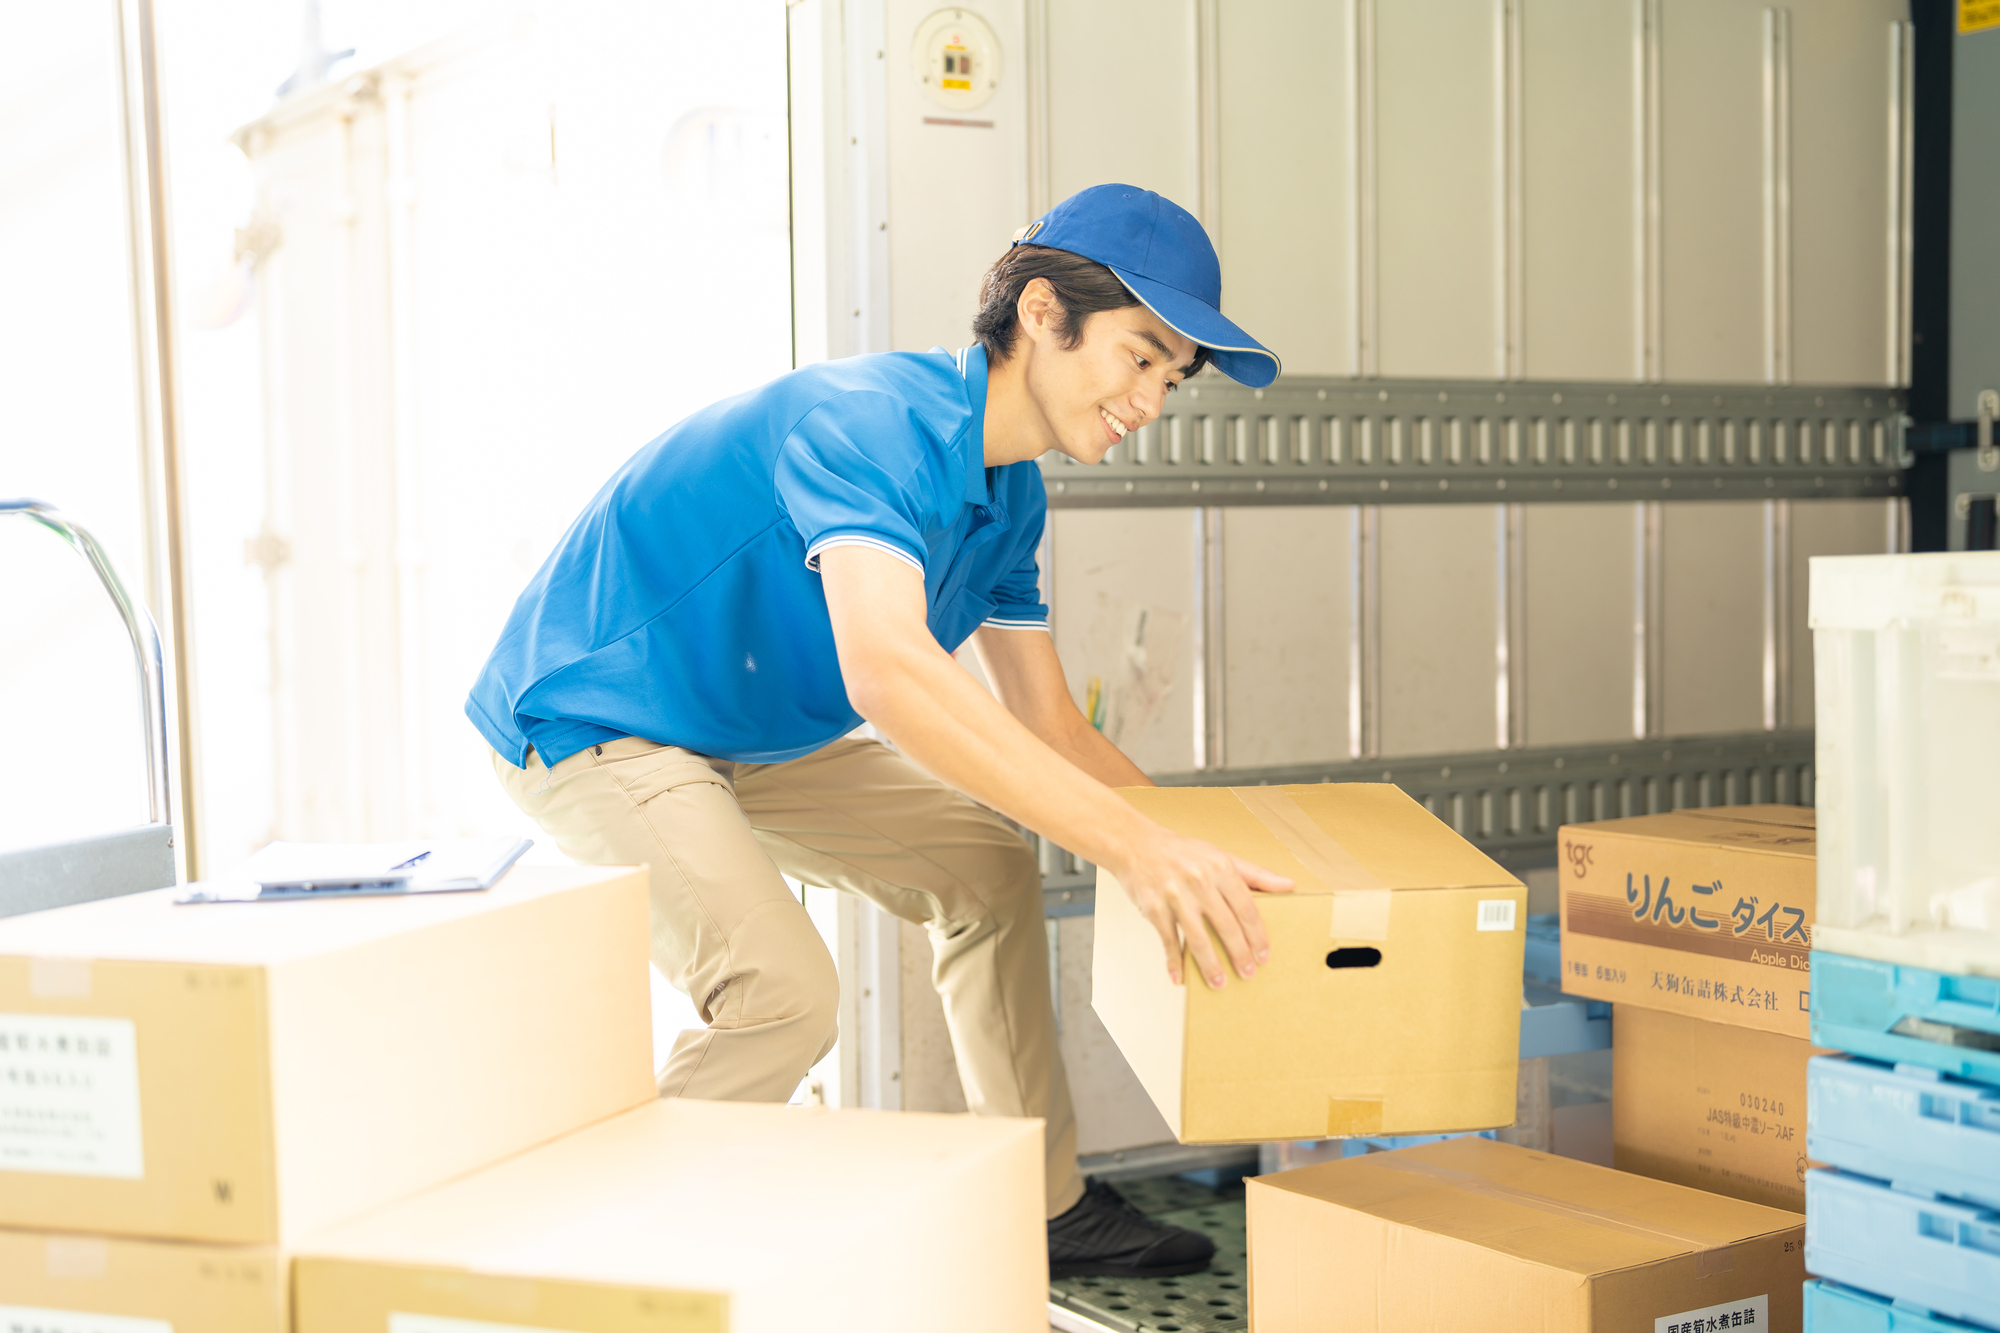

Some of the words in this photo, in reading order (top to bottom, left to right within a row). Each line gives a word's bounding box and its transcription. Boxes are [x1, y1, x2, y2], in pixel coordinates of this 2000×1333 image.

[1565, 839, 1594, 879] tgc
[1750, 948, 1787, 967] Apple
[1650, 970, 1779, 1011] 天狗缶詰株式会社
[1740, 1092, 1784, 1116] 030240
